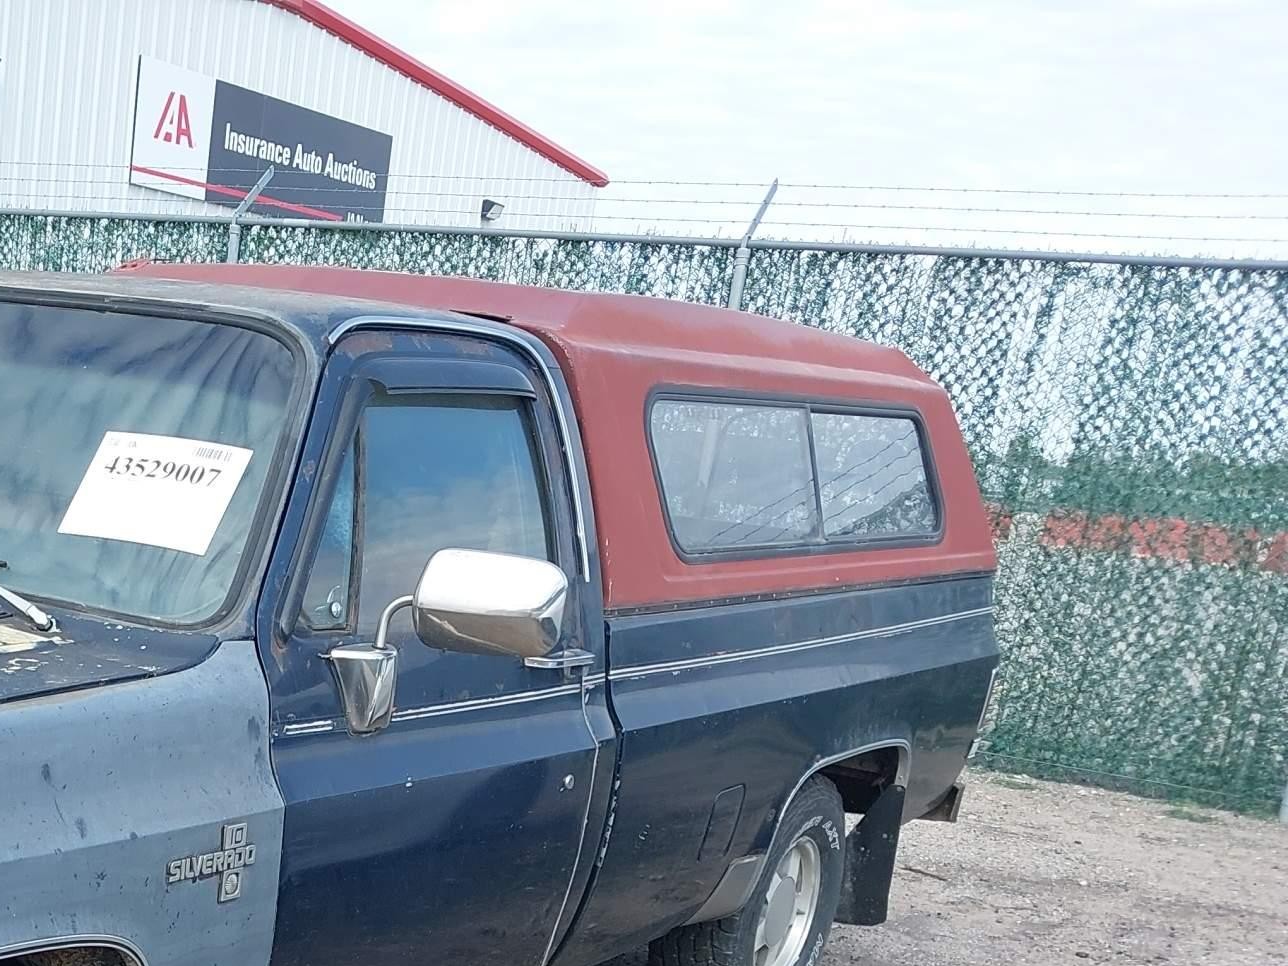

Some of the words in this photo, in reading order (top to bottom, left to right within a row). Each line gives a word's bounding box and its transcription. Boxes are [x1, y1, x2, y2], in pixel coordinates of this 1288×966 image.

[224, 122, 291, 166] Insurance
[292, 144, 323, 175] Auto
[323, 152, 377, 190] Auctions
[104, 455, 222, 488] 43529007
[223, 823, 247, 851] 10
[822, 820, 840, 850] AXT
[169, 844, 256, 883] SILVERADO
